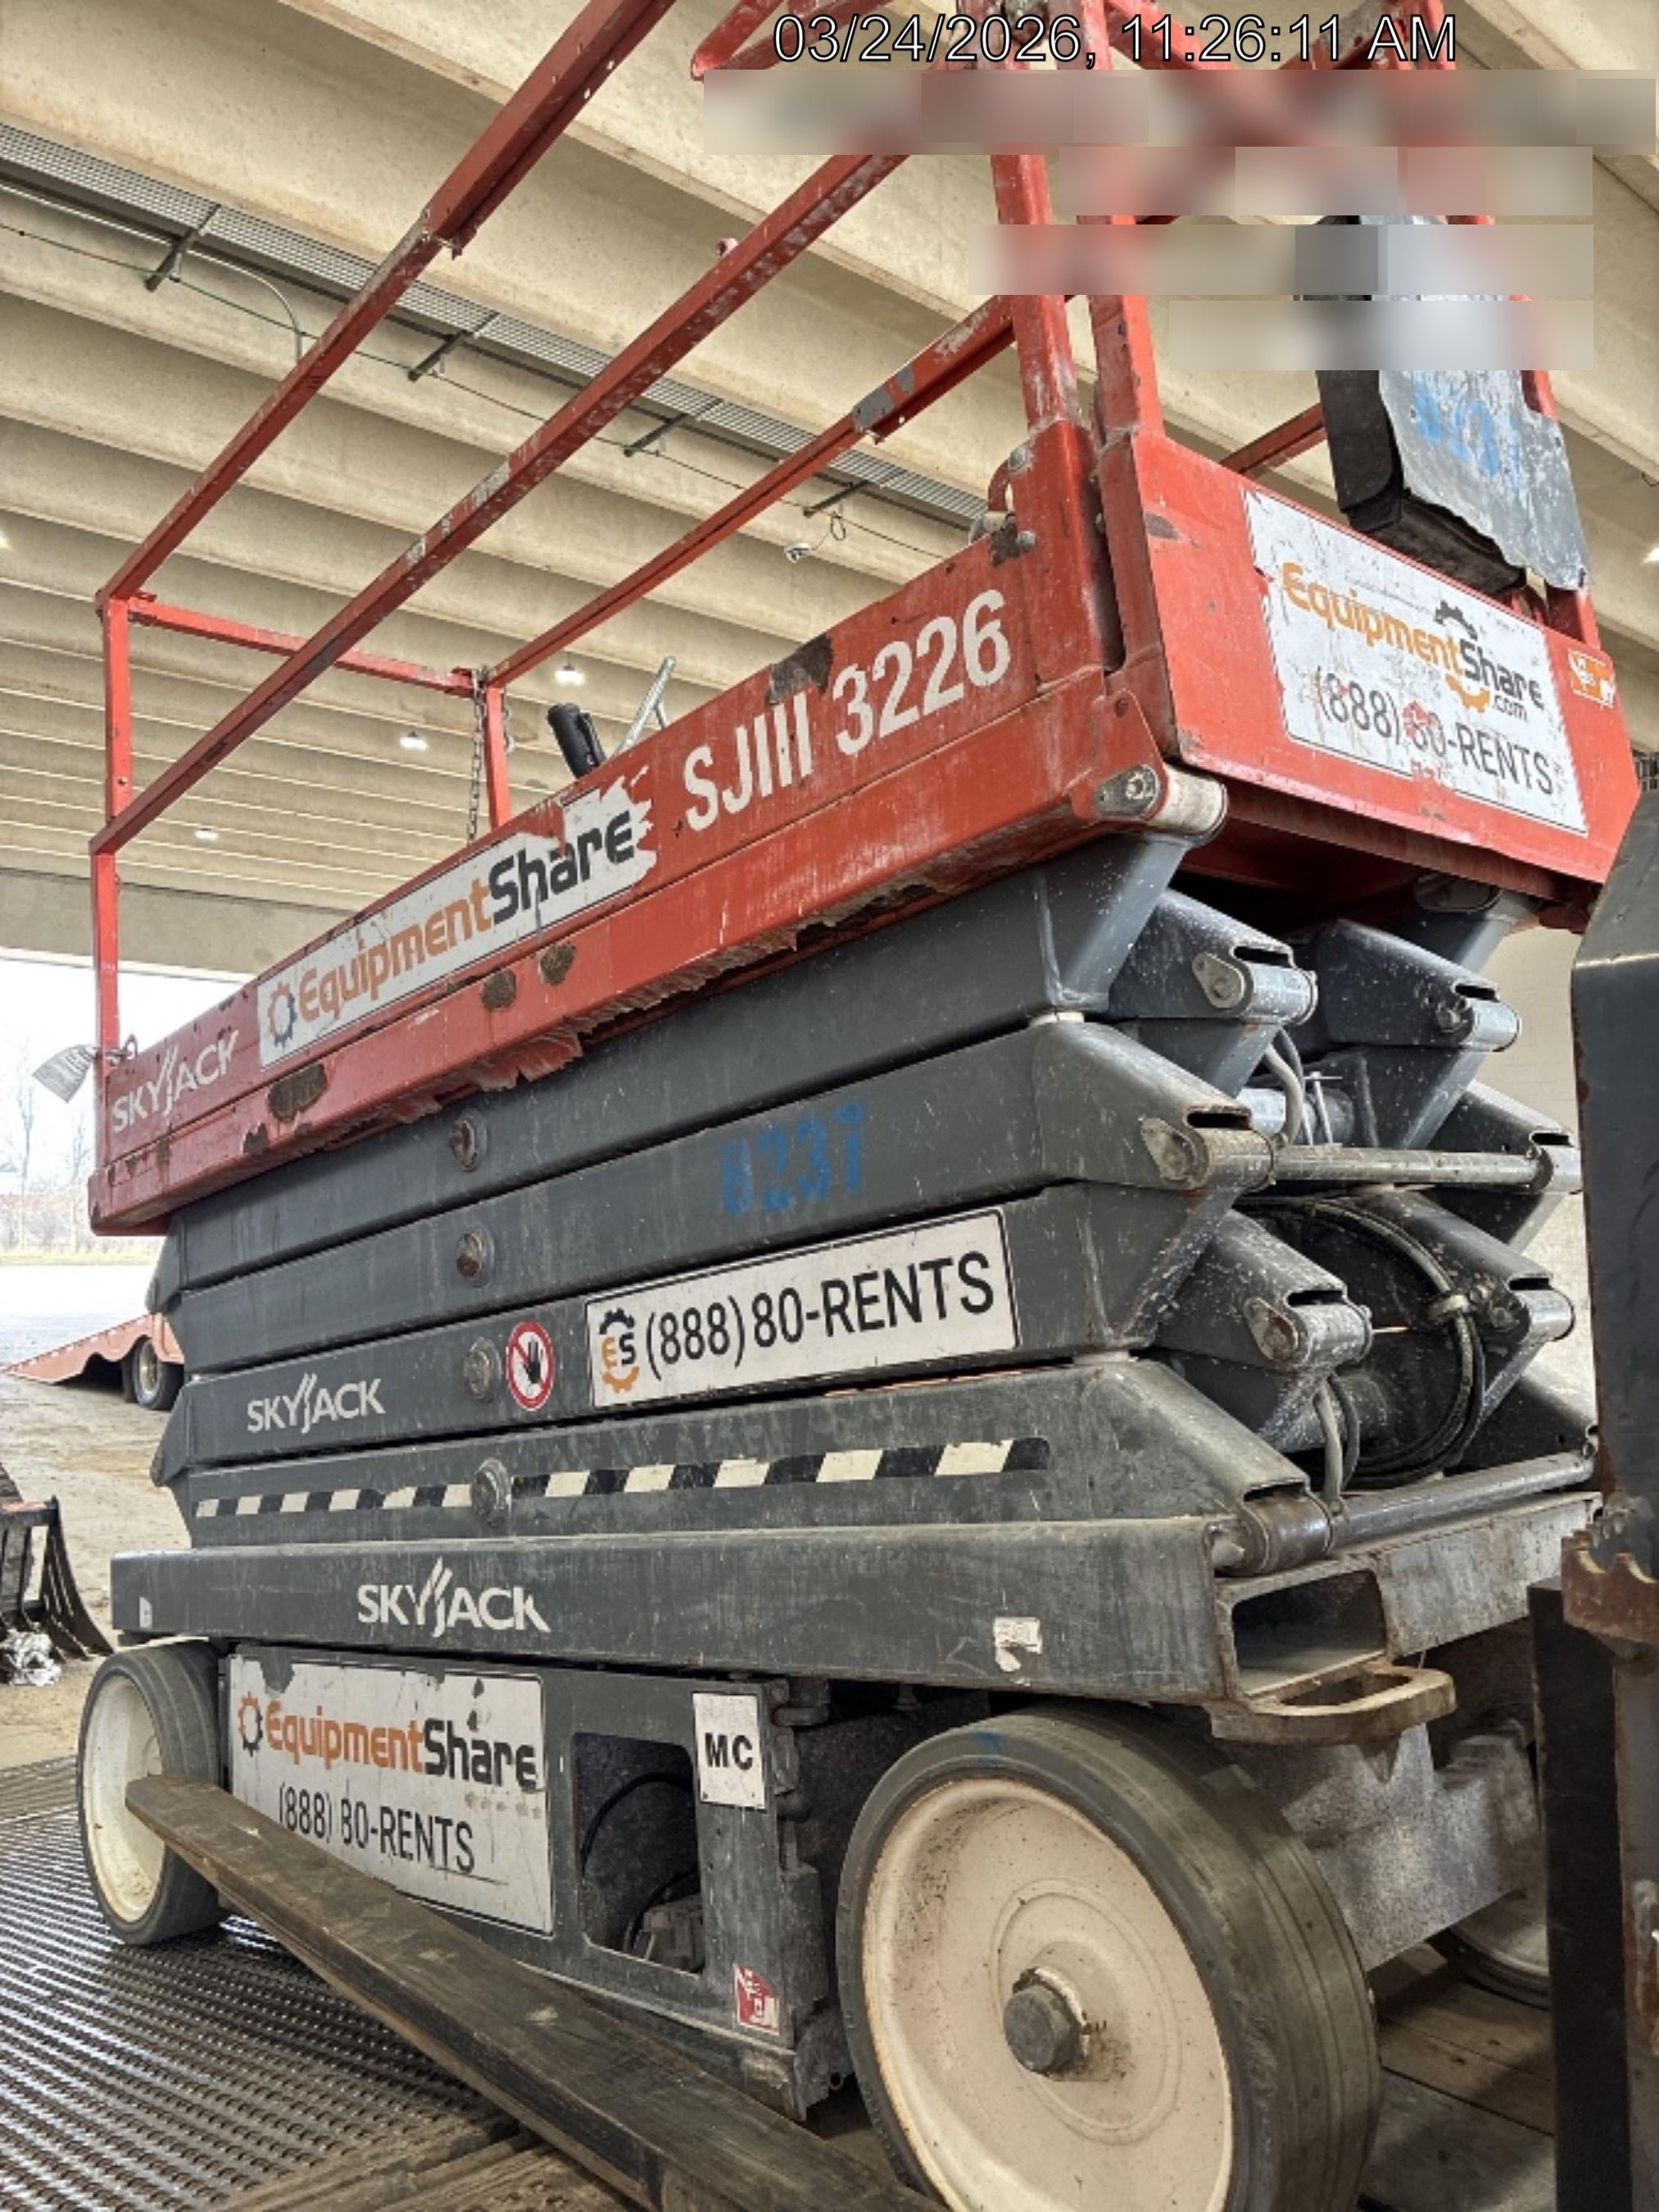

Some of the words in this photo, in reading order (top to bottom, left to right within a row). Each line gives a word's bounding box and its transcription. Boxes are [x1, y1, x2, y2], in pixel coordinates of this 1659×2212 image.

[1282, 562, 1545, 710] EquipmentShare
[683, 692, 814, 832] SJIII
[832, 589, 1011, 756] 3226
[298, 809, 636, 1022] EquipmentShare
[111, 1029, 238, 1133] SKYJACK
[247, 1373, 386, 1435] SKYJACK
[357, 1557, 551, 1637] SKYJACK
[265, 1700, 540, 1791] EquipmentShare
[705, 1732, 754, 1771] MC
